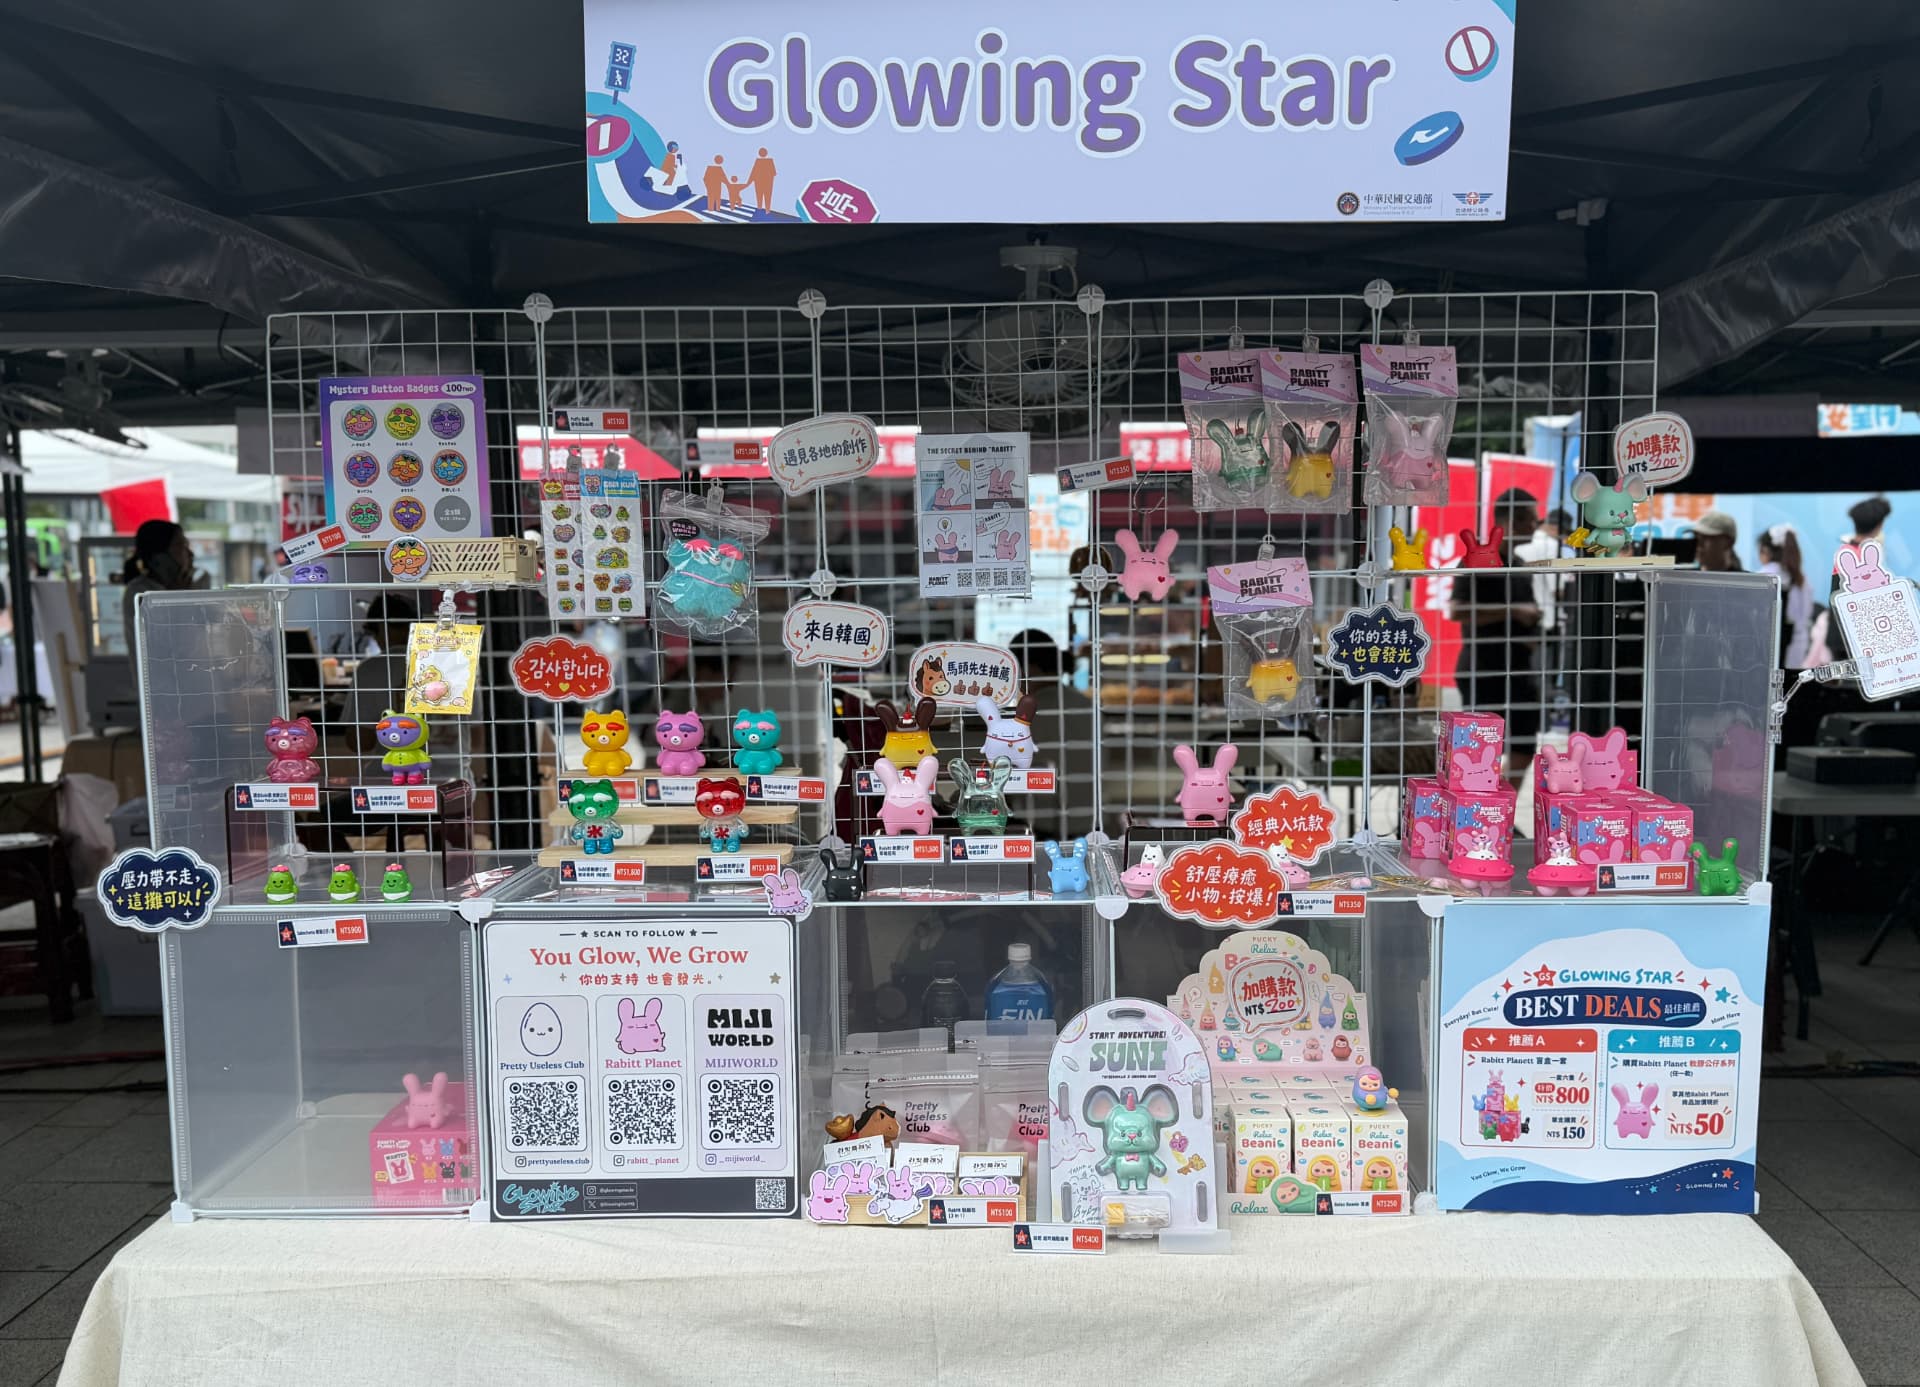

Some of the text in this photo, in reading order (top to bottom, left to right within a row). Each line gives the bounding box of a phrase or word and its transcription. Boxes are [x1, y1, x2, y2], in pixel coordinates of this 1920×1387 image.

[707, 31, 1392, 154] Glowing Star
[1210, 365, 1253, 376] RABITT
[1390, 361, 1430, 372] RABITT
[1210, 374, 1254, 385] PLANET
[1290, 368, 1329, 379] RABITT
[1390, 370, 1431, 381] PLANET
[1290, 377, 1330, 388] PLANET
[329, 385, 368, 395] Mystery
[371, 384, 404, 394] Button
[407, 384, 439, 393] Badges
[783, 437, 869, 467] 遇見各地的創作
[927, 447, 939, 455] THE
[940, 447, 963, 455] SECRET
[964, 446, 987, 454] BEHIND
[1626, 433, 1681, 460] 加購款
[1628, 460, 1648, 473] NT$
[1239, 574, 1282, 589] RABITT
[1240, 584, 1284, 598] PLANET
[804, 619, 871, 646] 來自韓國
[1352, 646, 1412, 664] 也會發光
[528, 657, 605, 680] 감사합니다
[946, 660, 1010, 683] 馬頭先生推薦
[1247, 814, 1325, 837] 經典入坑款
[1185, 864, 1257, 886] 舒壓療癒
[593, 929, 685, 938] SCAN TO FOLLOW
[1250, 944, 1278, 954] Relax
[529, 946, 749, 967] You Glow, We Grow
[578, 973, 639, 986] 你的支持
[1538, 969, 1673, 985] GS GLOWING STAR
[1241, 977, 1297, 1002] 加購款
[1244, 998, 1296, 1017] NT$ 200
[1515, 994, 1701, 1020] BEST DEALS 最佳推薦
[707, 1008, 773, 1029] MIJI
[708, 1034, 774, 1047] WORLD
[1089, 1030, 1167, 1040] START ADVENTURE!
[605, 1057, 682, 1069] Rabitt Planet
[705, 1057, 778, 1068] MIJIWORLD
[1089, 1041, 1168, 1072] SUNI
[1481, 1056, 1505, 1064] Rabitt
[500, 1059, 585, 1072] Pretty Useless Club
[1663, 1060, 1688, 1068] Planet
[905, 1101, 938, 1112] Pretty
[905, 1111, 947, 1122] Useless
[906, 1124, 930, 1133] Club
[1018, 1125, 1044, 1136] Club
[990, 1208, 1013, 1217] NT$100
[1230, 1201, 1269, 1215] Relax
[1076, 1235, 1099, 1243] NT$400
